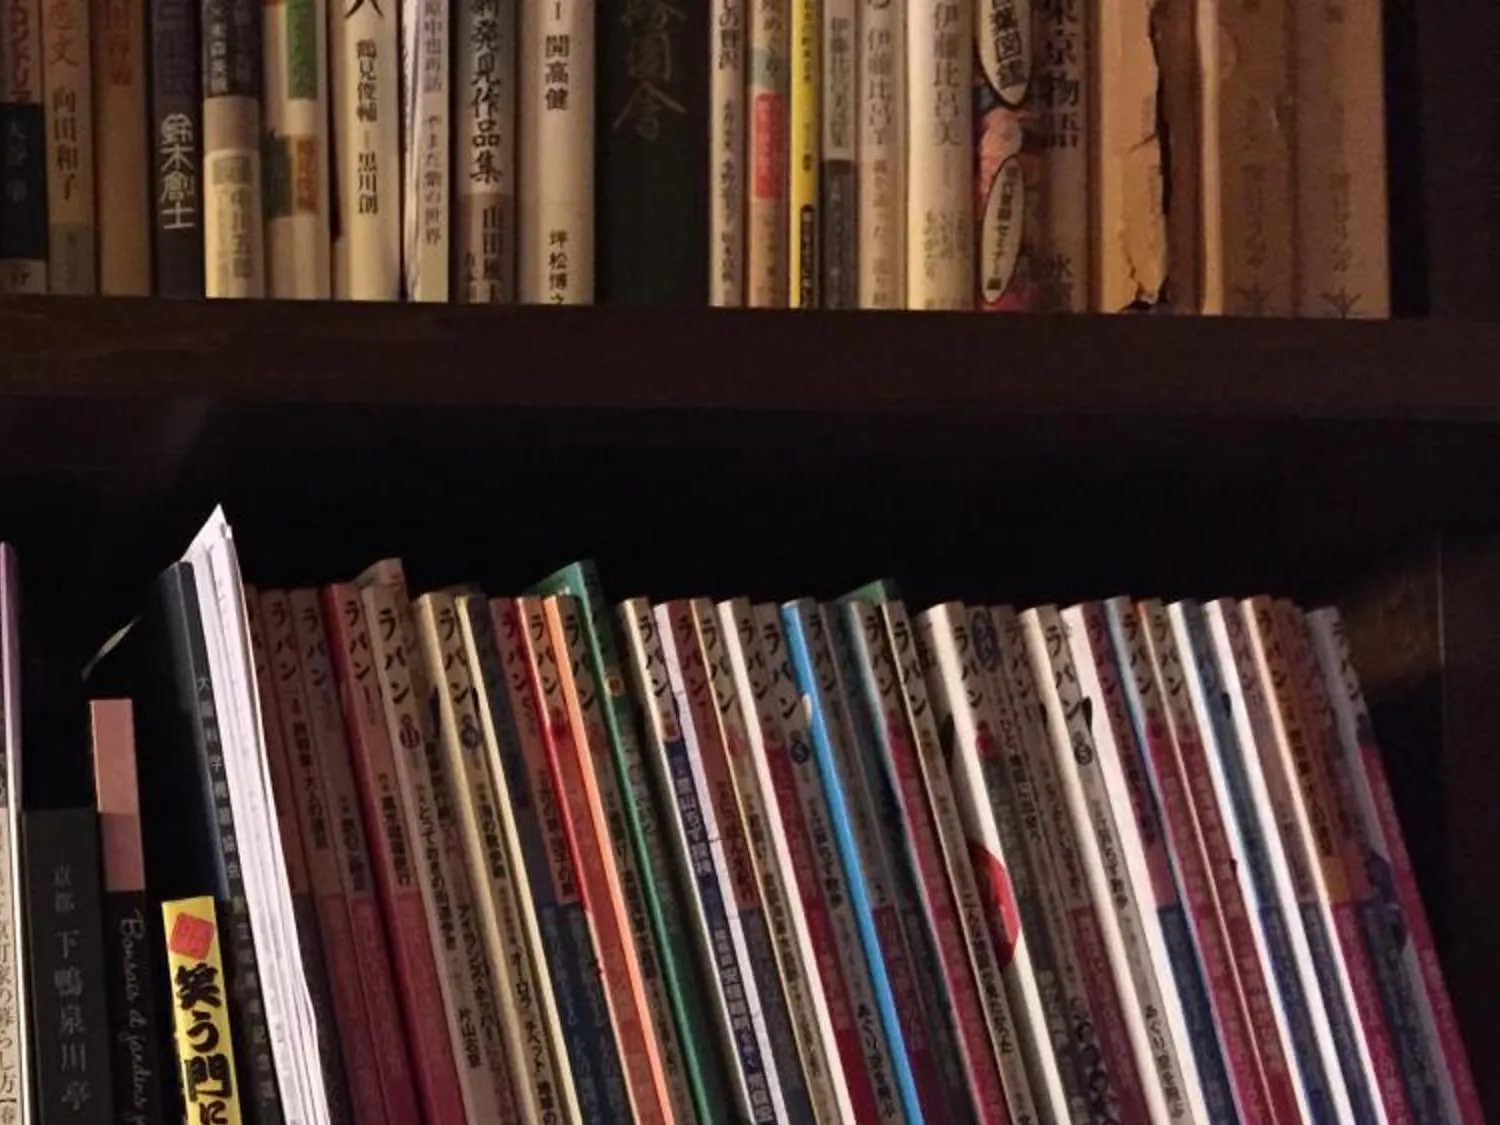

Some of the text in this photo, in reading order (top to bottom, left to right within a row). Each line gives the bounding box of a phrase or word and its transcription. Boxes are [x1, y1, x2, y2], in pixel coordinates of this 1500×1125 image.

[543, 33, 571, 112] 開高健
[159, 112, 196, 231] 鈴木創士
[344, 600, 372, 682] ラパン
[376, 607, 411, 705] ラパン
[438, 607, 471, 705] ラパン
[637, 615, 671, 698] ラパン
[700, 617, 734, 713] ラパン
[762, 621, 799, 720] ラパン
[893, 620, 929, 719] ラパン
[1044, 625, 1083, 722] ラパン
